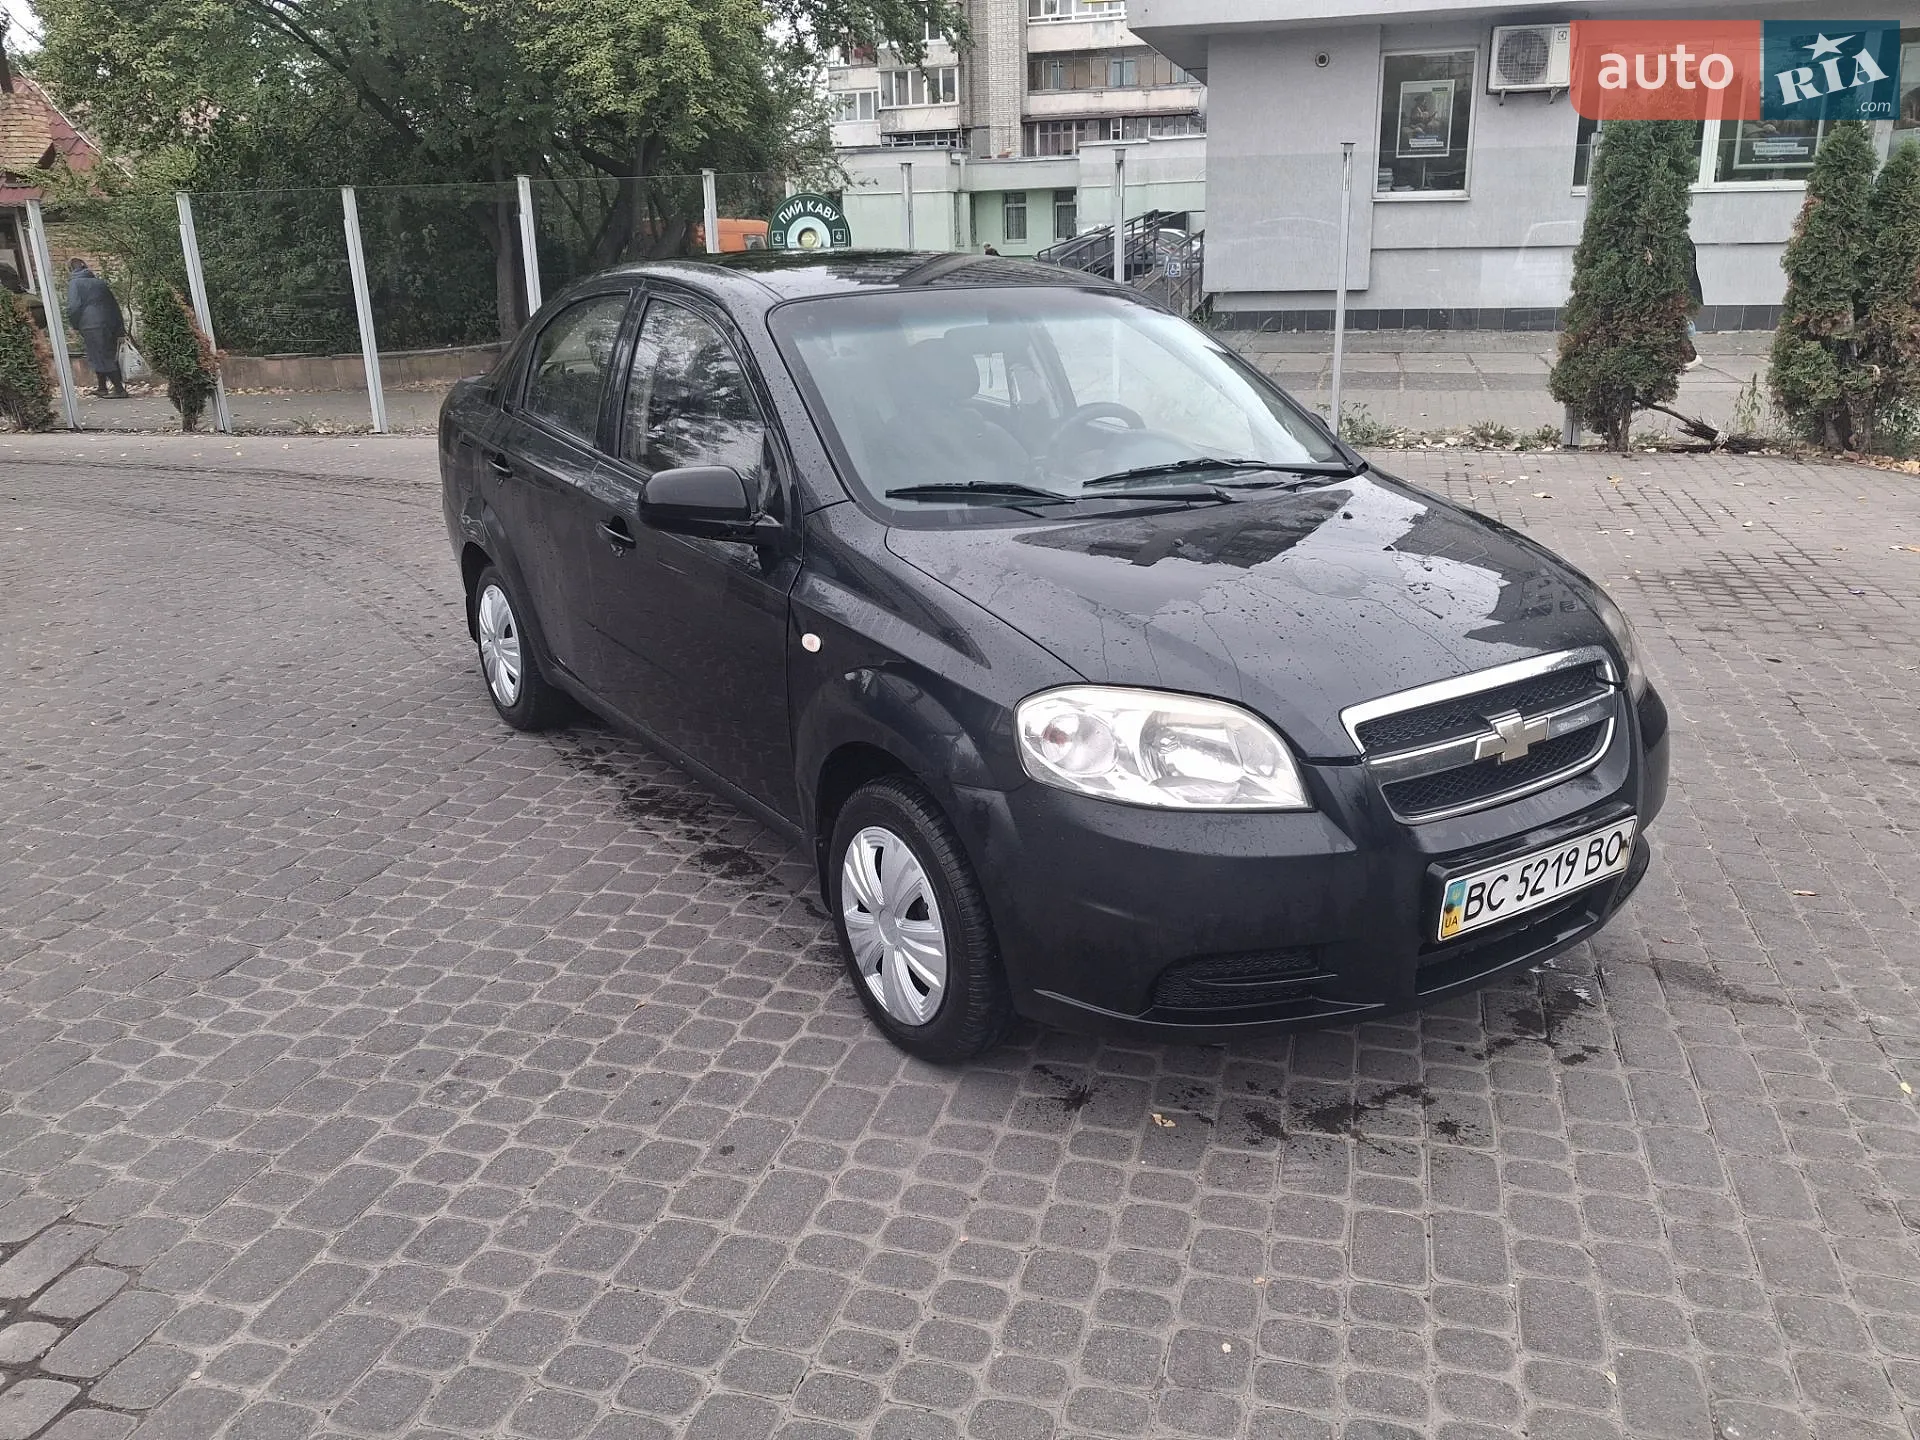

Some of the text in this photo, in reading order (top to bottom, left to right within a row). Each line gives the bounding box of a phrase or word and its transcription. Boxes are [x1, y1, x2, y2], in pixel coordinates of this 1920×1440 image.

[778, 199, 839, 224] ПИЙ КАВУ
[1516, 847, 1580, 902] 5219
[1444, 915, 1459, 928] UA
